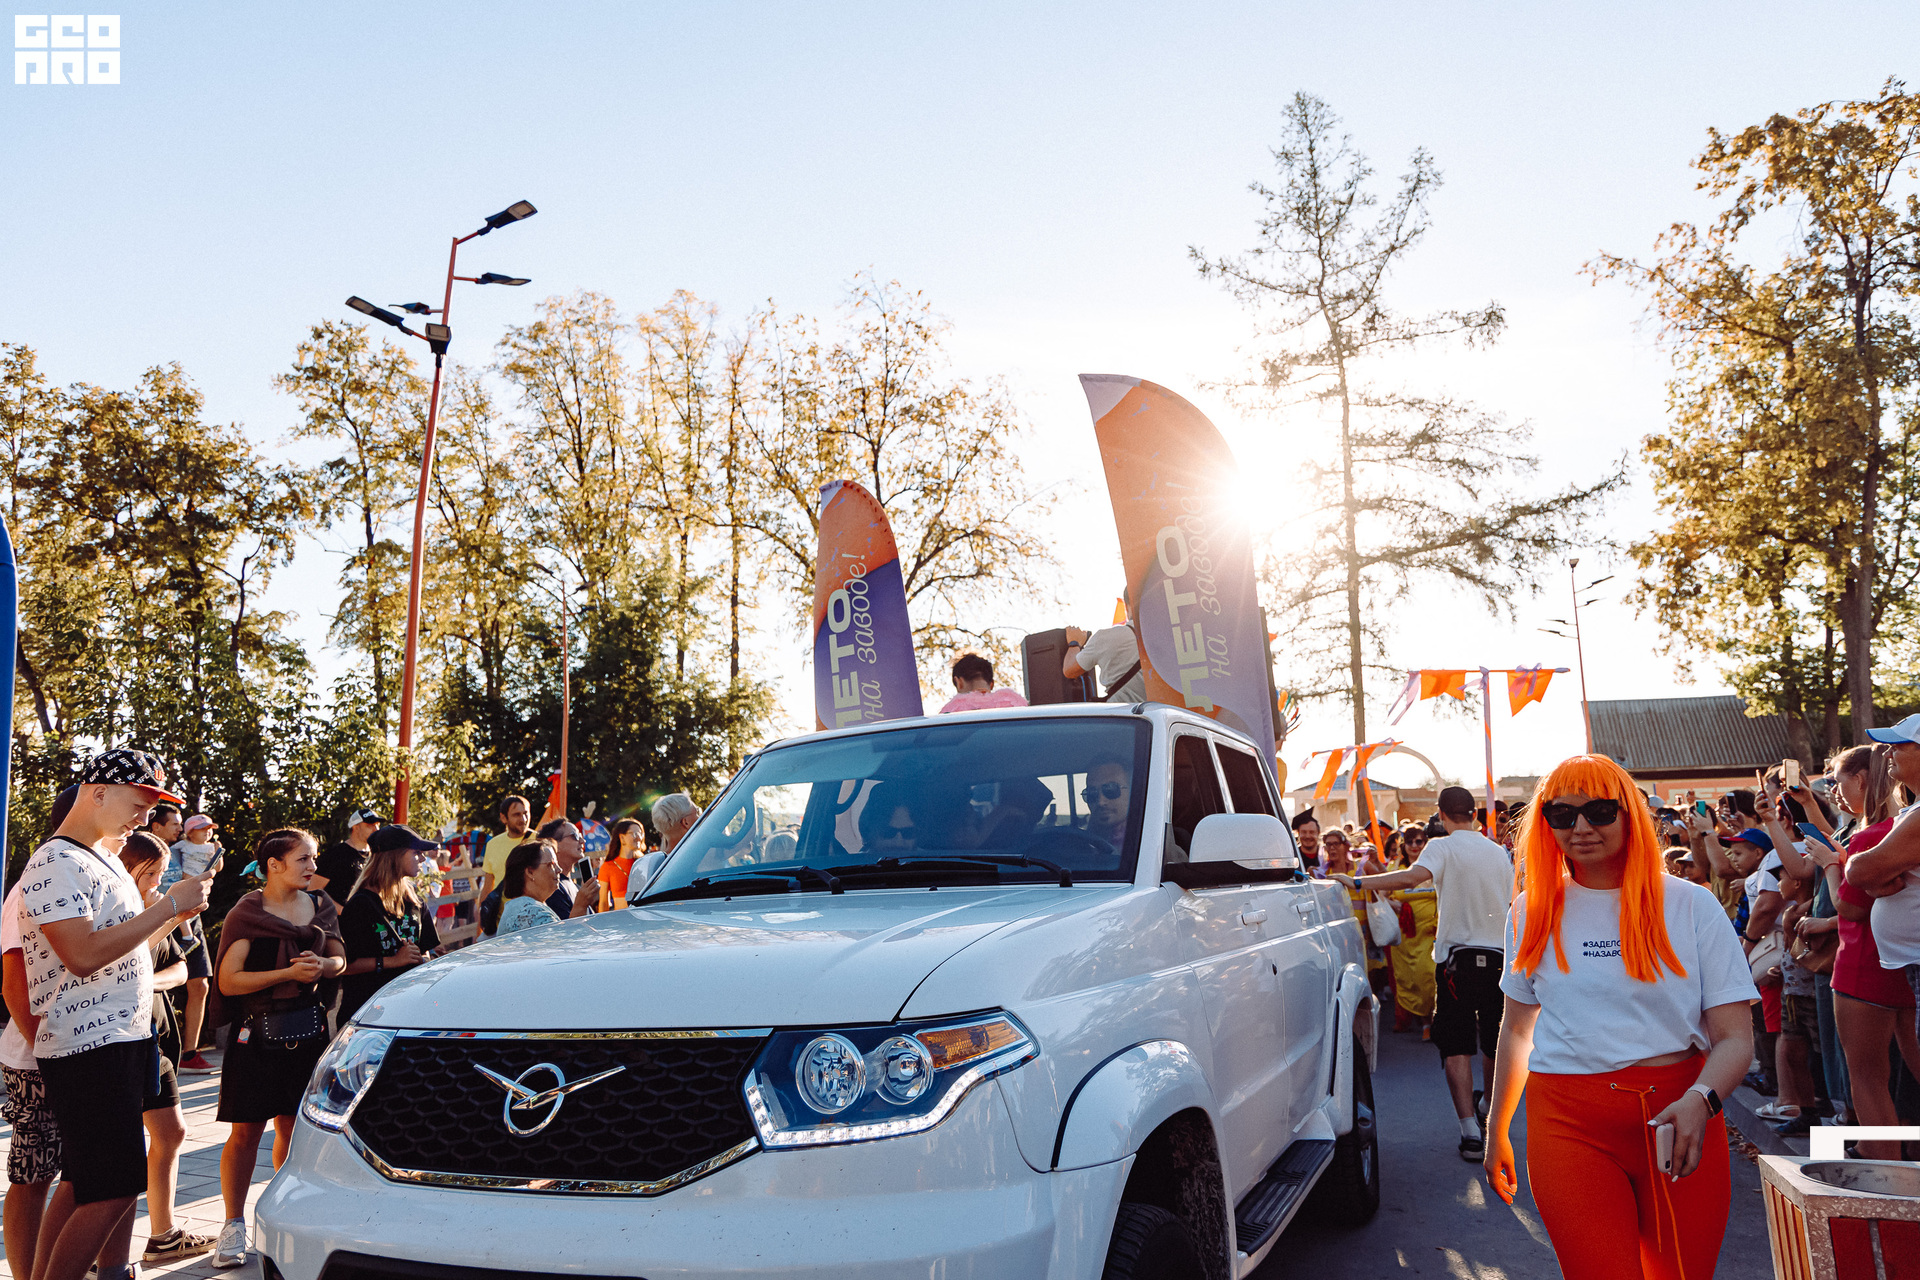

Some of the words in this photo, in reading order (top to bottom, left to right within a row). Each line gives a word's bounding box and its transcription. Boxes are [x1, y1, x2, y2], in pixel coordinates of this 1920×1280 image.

[841, 553, 877, 665] заводе!
[1156, 524, 1213, 713] ЛЕТО
[1208, 633, 1232, 678] на
[861, 680, 884, 720] на
[58, 972, 100, 993] MALE
[117, 967, 145, 985] KING
[65, 992, 109, 1014] WOLF
[73, 1013, 116, 1036] MALE
